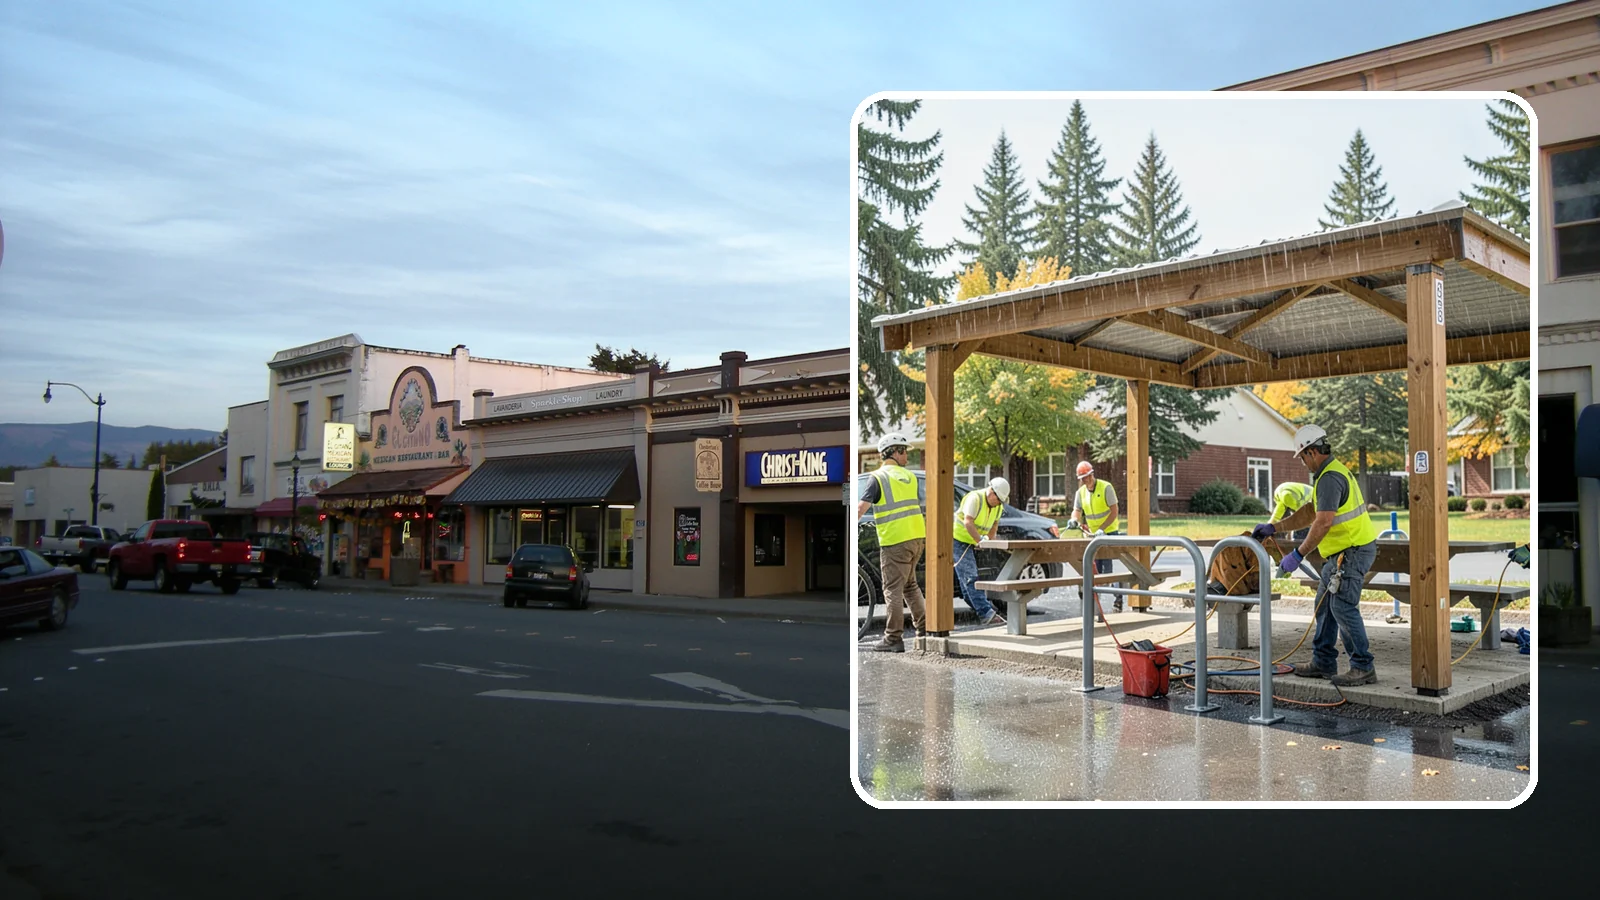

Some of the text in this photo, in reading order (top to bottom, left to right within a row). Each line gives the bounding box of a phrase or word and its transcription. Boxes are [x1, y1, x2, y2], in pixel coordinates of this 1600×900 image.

[493, 389, 623, 412] LAVANDERIA Sparkle Shop LAUNDRY
[373, 455, 396, 464] MEXICAN
[397, 452, 433, 462] RESTAURANT
[437, 450, 450, 459] BAR
[760, 450, 827, 478] CHRIST KING
